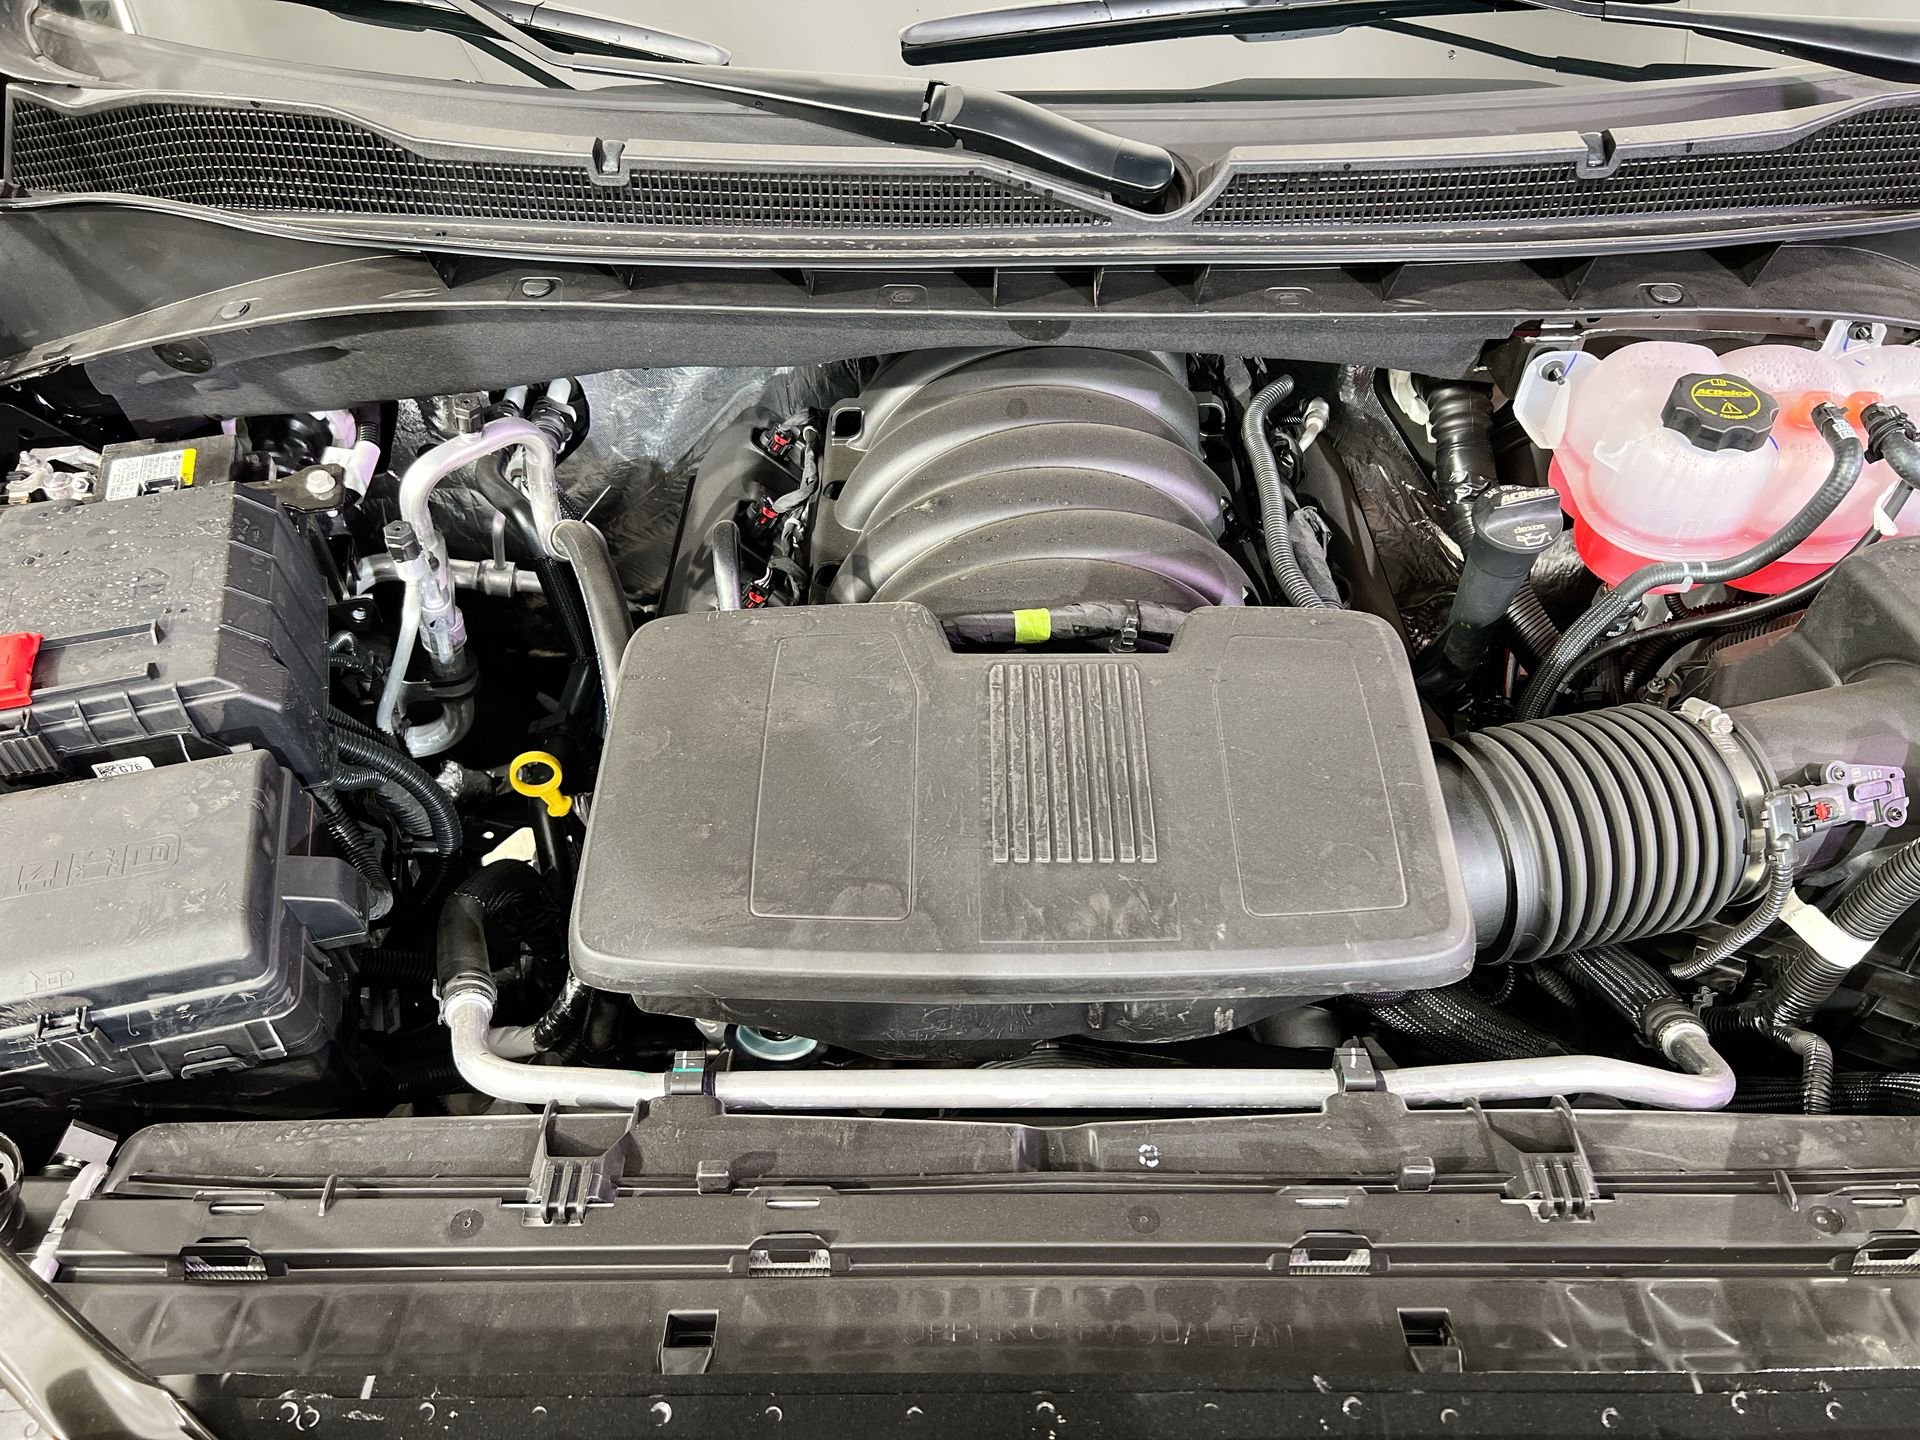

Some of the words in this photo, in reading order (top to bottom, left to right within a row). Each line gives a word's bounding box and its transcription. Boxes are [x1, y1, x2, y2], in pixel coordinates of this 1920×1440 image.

[1695, 388, 1753, 397] ACDelco
[1484, 488, 1500, 499] SAE
[1501, 488, 1556, 505] ACDelco
[1514, 524, 1546, 534] dexos
[119, 763, 143, 774] G76
